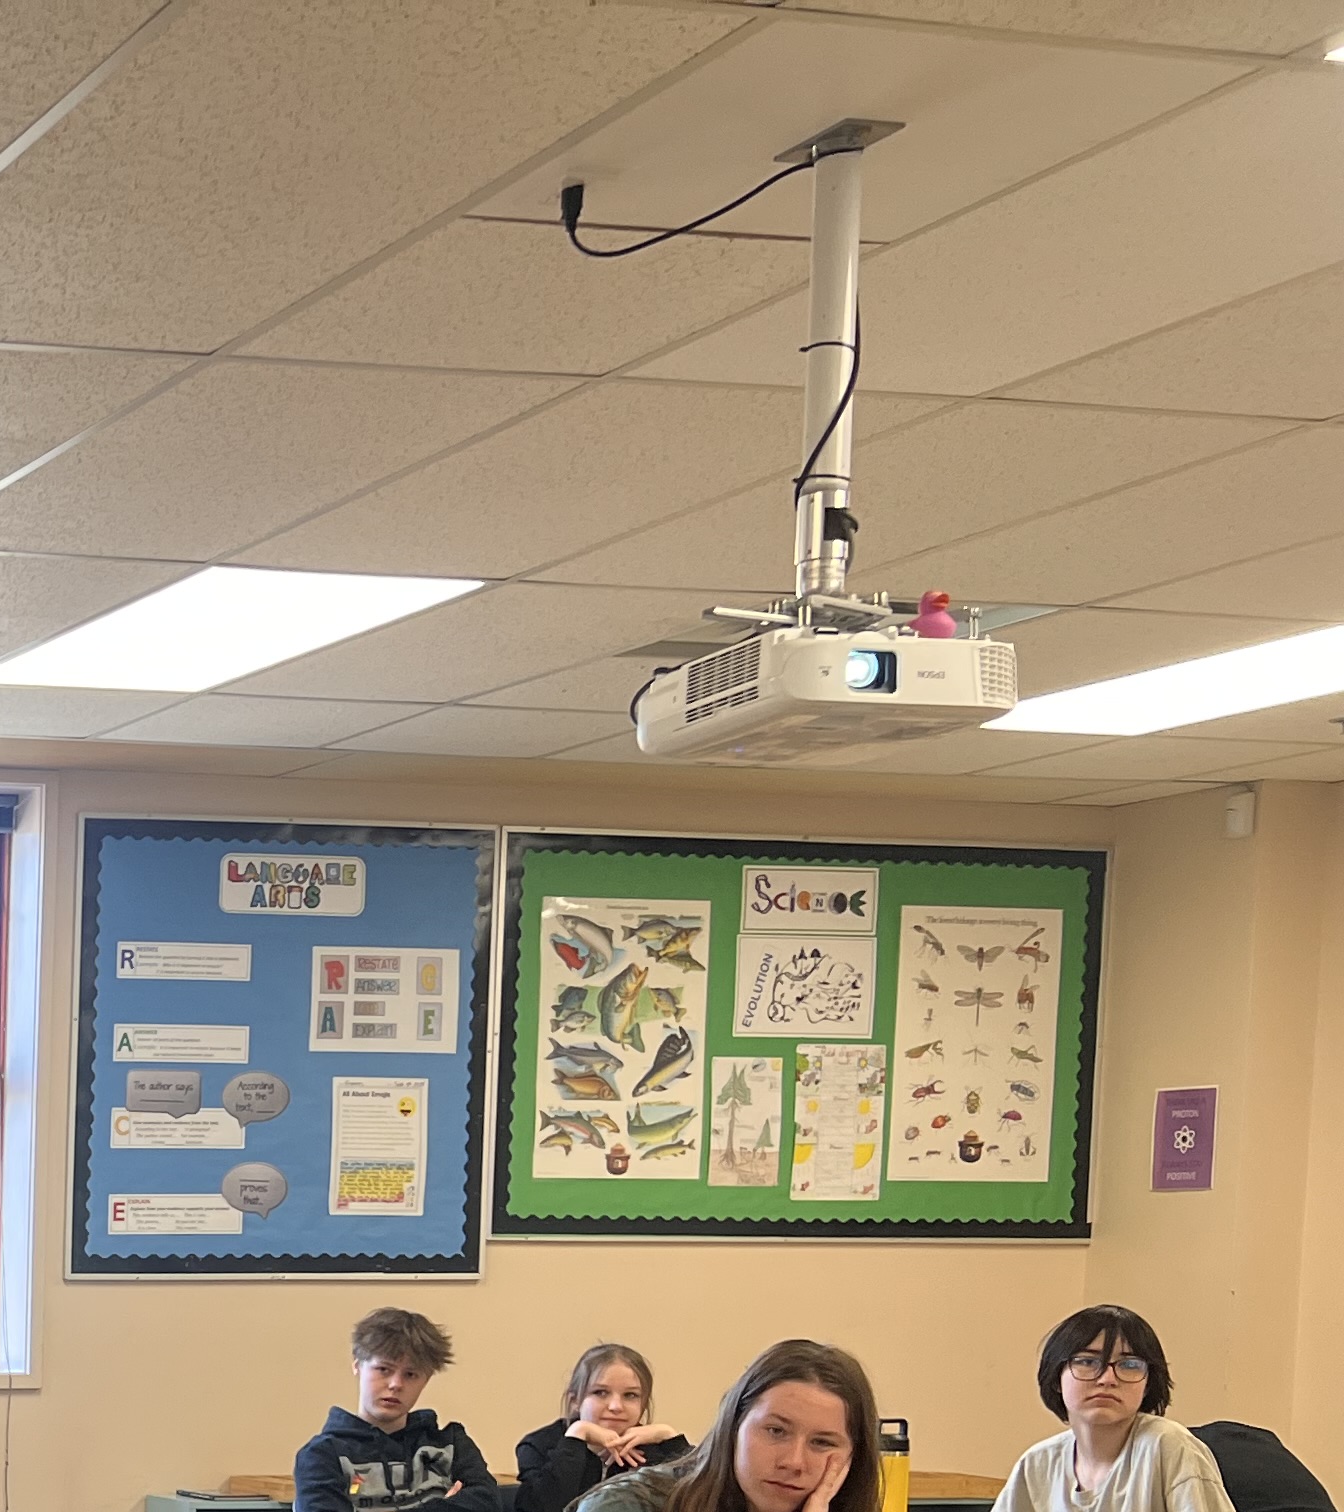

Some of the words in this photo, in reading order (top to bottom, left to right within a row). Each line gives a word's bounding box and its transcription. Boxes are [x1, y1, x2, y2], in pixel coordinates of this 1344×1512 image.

[917, 671, 946, 680] EPSON
[120, 949, 135, 969] R
[324, 960, 345, 991] R
[742, 952, 774, 1028] EVOLUTION
[320, 1006, 337, 1034] A
[422, 1009, 435, 1036] E
[117, 1032, 133, 1052] A
[134, 1080, 146, 1090] The
[149, 1081, 173, 1090] author
[237, 1081, 275, 1093] According
[243, 1092, 253, 1100] to
[255, 1092, 267, 1100] the
[240, 1184, 268, 1198] proves
[113, 1202, 126, 1222] E
